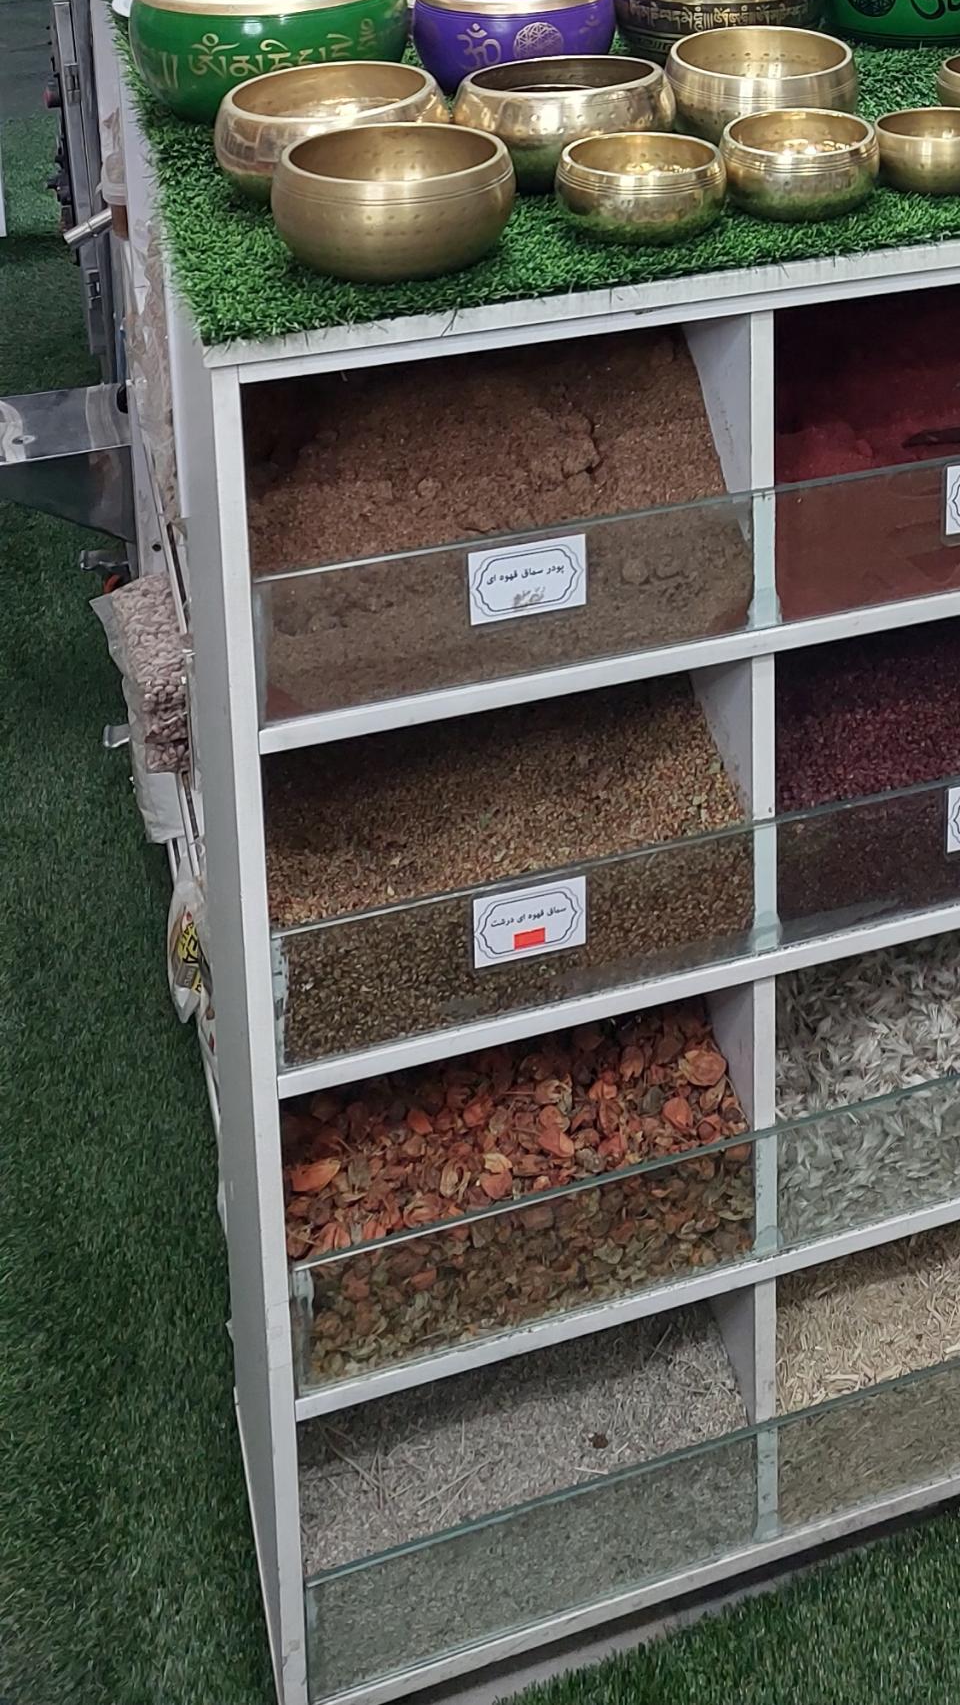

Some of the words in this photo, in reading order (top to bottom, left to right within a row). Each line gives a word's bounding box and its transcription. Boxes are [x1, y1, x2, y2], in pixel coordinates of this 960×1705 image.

[521, 566, 543, 579] سماق
[546, 563, 565, 575] پودر
[486, 574, 497, 585] ای
[499, 569, 518, 583] قهوه
[528, 909, 545, 921] قهوه
[546, 906, 567, 917] سماق
[490, 917, 515, 928] درشت
[516, 914, 526, 923] ای
